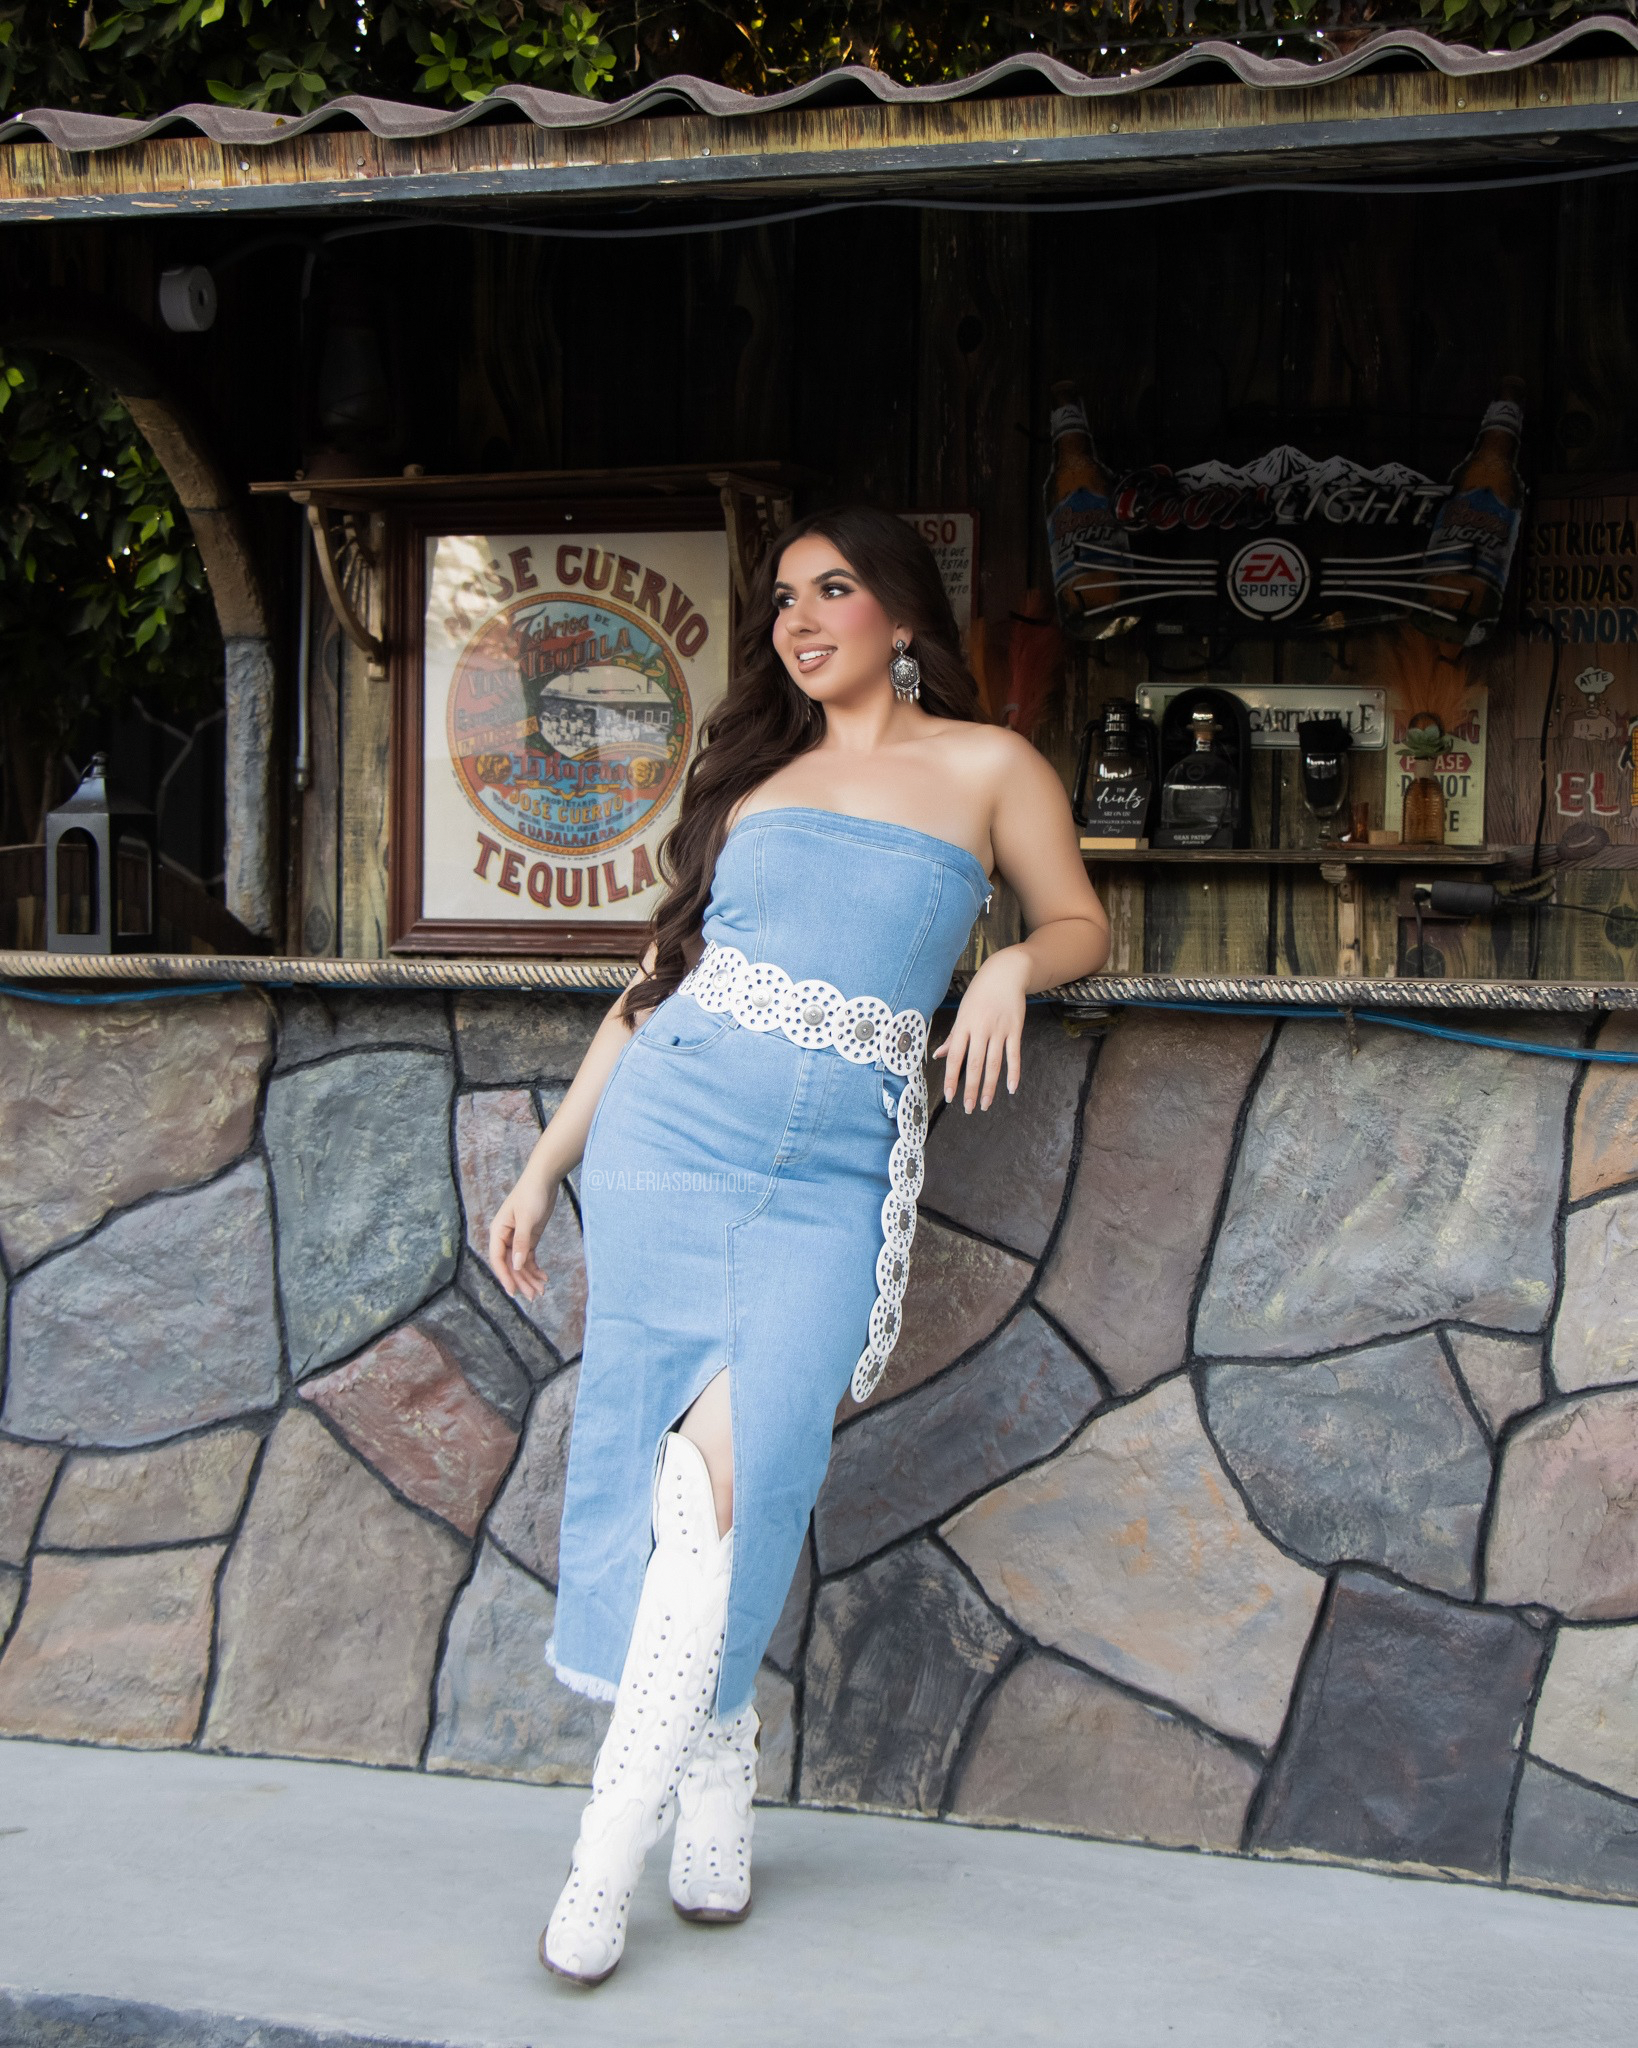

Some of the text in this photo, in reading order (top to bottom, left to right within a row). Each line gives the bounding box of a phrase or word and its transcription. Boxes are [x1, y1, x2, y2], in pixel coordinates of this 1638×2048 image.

[1115, 464, 1454, 531] Coors LIGHT
[1058, 526, 1115, 553] LIGHT
[1439, 525, 1503, 549] LIGHT
[1241, 553, 1297, 582] EA
[1239, 584, 1299, 597] SPORTS
[1520, 564, 1634, 603] BEBIDAS
[555, 545, 710, 658] CUERVO
[594, 613, 610, 628] DE
[520, 627, 634, 682] TEQUILA
[1579, 671, 1609, 687] ATTE
[1405, 754, 1465, 770] PASE
[557, 793, 625, 824] CUERVO
[1096, 786, 1146, 810] drinks
[1555, 771, 1620, 817] EL
[473, 832, 659, 909] TEQUILA
